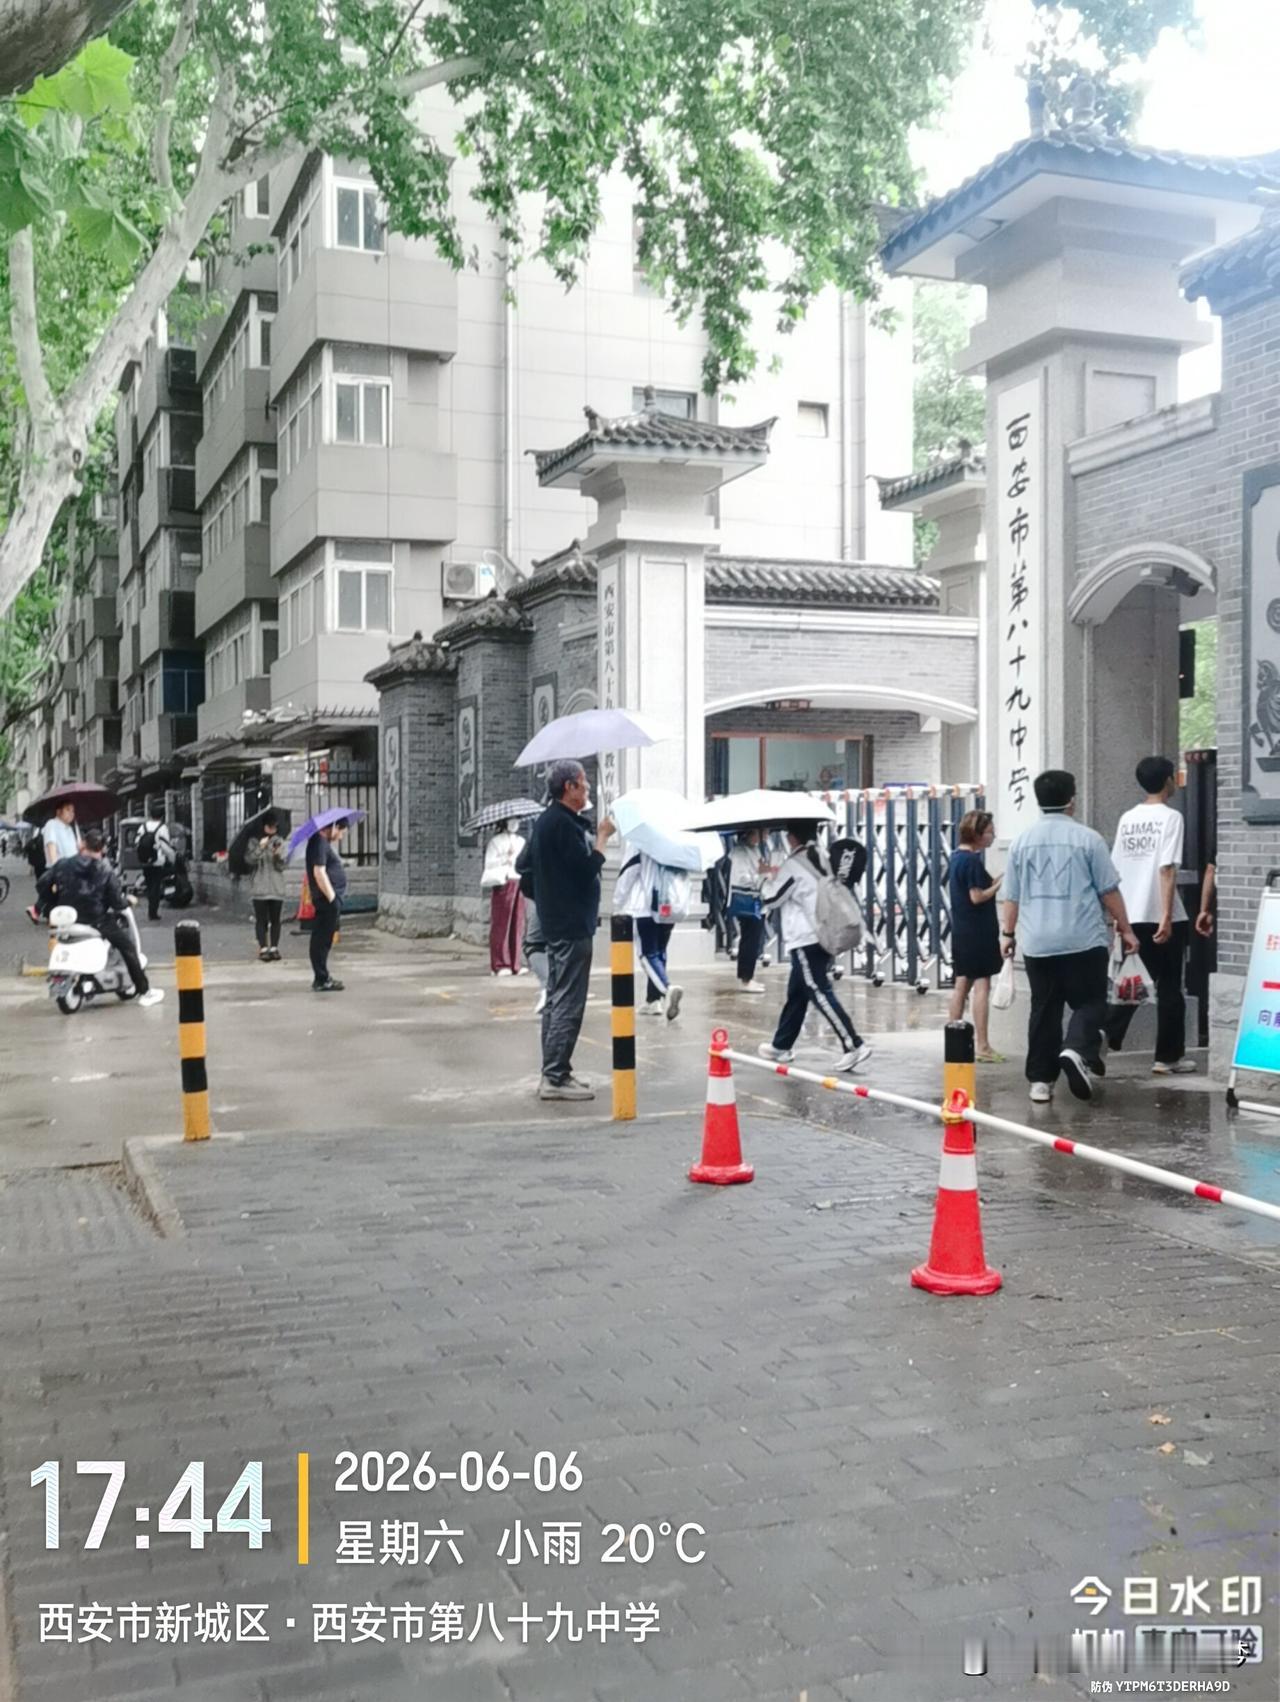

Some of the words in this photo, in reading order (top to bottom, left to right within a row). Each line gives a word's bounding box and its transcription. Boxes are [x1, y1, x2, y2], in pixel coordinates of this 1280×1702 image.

[1006, 413, 1031, 812] 西安市第八十九中学
